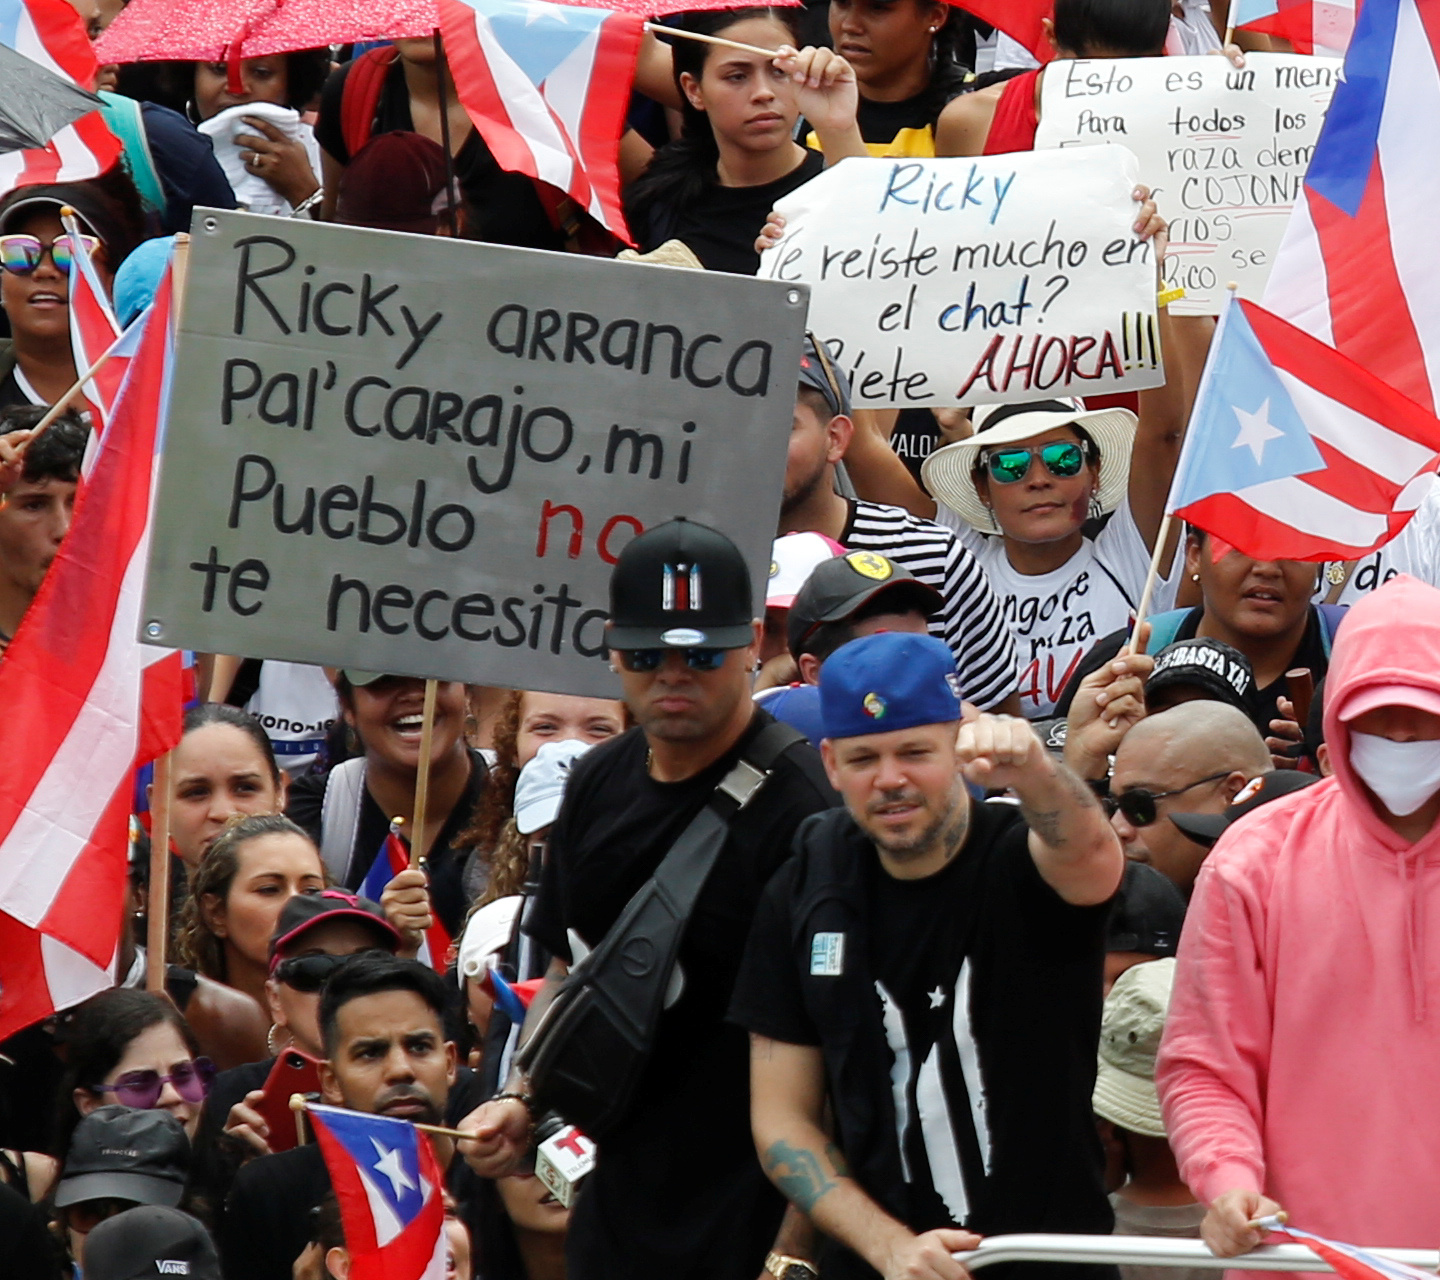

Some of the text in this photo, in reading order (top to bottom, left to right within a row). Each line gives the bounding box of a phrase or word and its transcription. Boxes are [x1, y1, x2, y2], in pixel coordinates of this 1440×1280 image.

[1065, 60, 1255, 99] Esto es un
[1169, 107, 1246, 135] todos
[1274, 107, 1307, 133] los
[1167, 146, 1240, 174] raza
[878, 162, 1017, 226] Ricky
[820, 227, 940, 281] reiste
[953, 219, 1089, 273] mucho
[1102, 234, 1148, 268] en
[1231, 248, 1268, 269] se
[233, 234, 443, 370] Ricky
[878, 275, 1070, 333] el chat?
[956, 311, 1160, 401] AHORA!!!
[604, 422, 697, 485] mi
[228, 454, 476, 552] Pueblo
[190, 546, 271, 617] te
[155, 1259, 190, 1276] VANS
